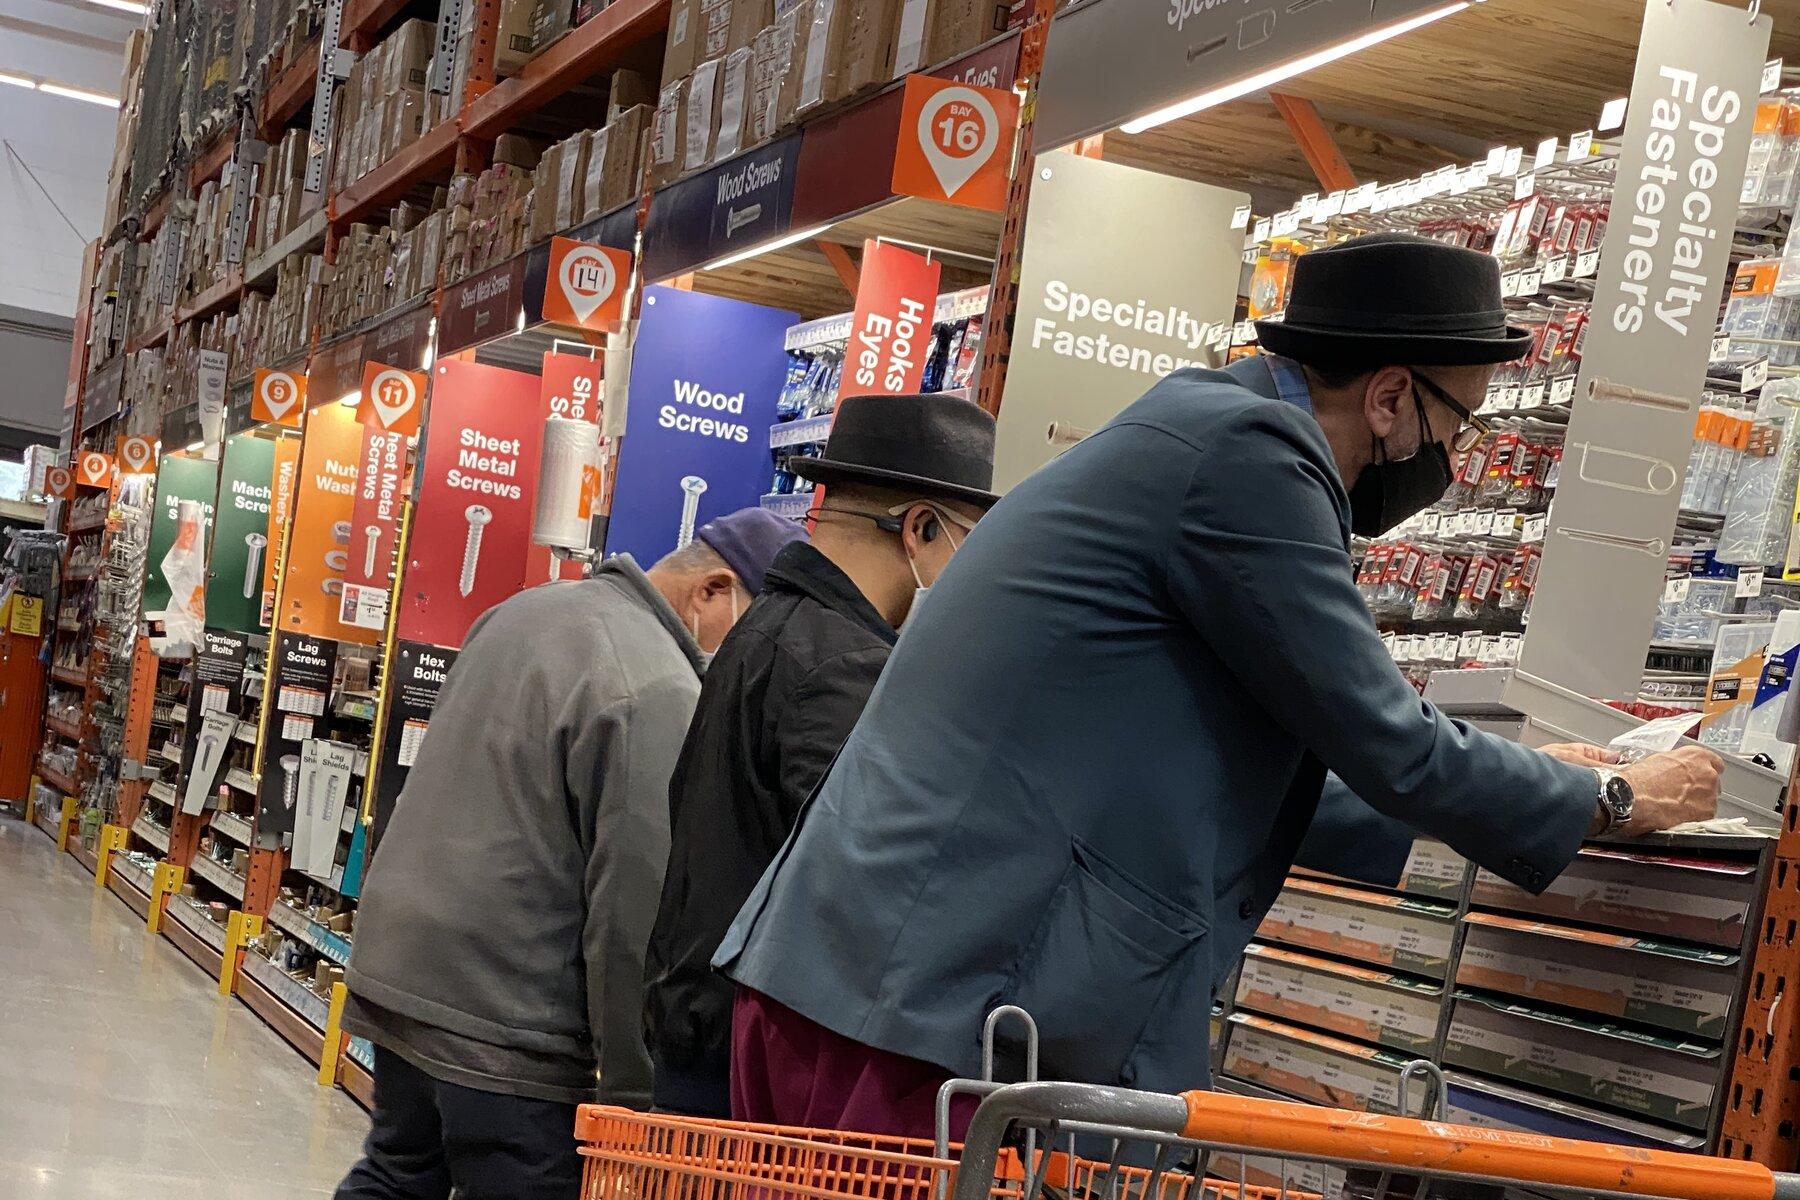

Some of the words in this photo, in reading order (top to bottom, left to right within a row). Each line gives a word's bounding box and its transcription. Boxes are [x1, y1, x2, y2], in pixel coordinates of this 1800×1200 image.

[950, 105, 972, 116] BAY
[939, 117, 980, 151] 16
[717, 166, 746, 205] Wood
[745, 157, 782, 193] Screws
[1613, 64, 1698, 333] Fasteners
[1654, 85, 1741, 336] Specialty
[578, 267, 599, 289] 14
[1043, 280, 1211, 350] Specialty
[856, 312, 892, 387] Eyes
[884, 297, 925, 392] Hooks
[273, 386, 285, 399] 9
[382, 386, 403, 405] 11
[572, 375, 593, 425] She
[673, 379, 745, 414] Wood
[658, 405, 749, 443] Screws
[383, 431, 402, 470] heet
[460, 428, 521, 456] Sheet
[363, 435, 386, 499] Screws
[459, 449, 517, 477] Metal
[232, 480, 271, 500] Mach
[276, 461, 293, 525] Washers
[377, 473, 398, 521] Metal
[446, 469, 521, 500] Screws
[234, 496, 271, 514] Scre
[205, 633, 242, 648] Carriage
[211, 645, 234, 656] Bolts
[298, 641, 319, 656] Lag
[287, 651, 327, 667] Screws
[419, 653, 446, 669] Hex
[413, 666, 447, 683] Bolts
[322, 759, 349, 772] Shields
[330, 751, 345, 763] Lag
